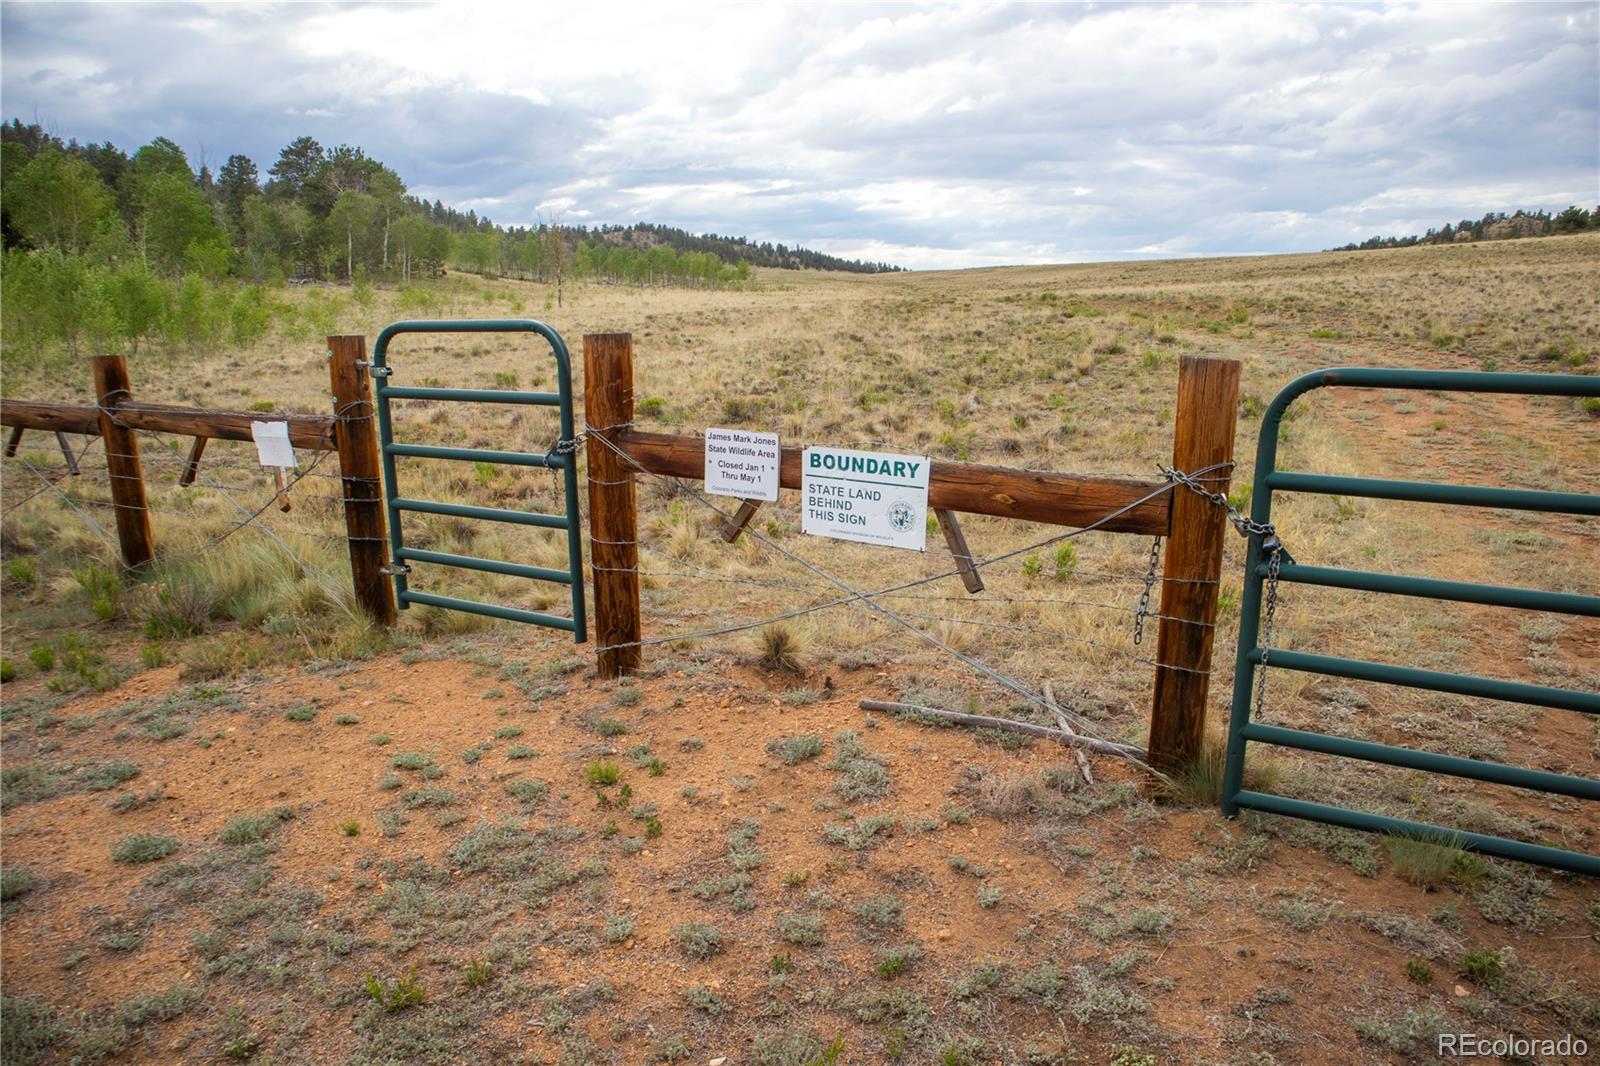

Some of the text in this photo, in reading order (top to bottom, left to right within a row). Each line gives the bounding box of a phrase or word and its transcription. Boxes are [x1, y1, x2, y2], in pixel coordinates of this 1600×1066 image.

[708, 432, 776, 446] James Mark Jones
[708, 444, 775, 458] State Wildlife Area
[718, 460, 744, 470] Closed
[745, 464, 759, 472] Jan
[810, 453, 920, 479] BOUNDARY
[721, 471, 738, 480] Thru
[740, 473, 755, 484] May
[809, 483, 882, 502] STATE LAND
[809, 496, 853, 511] BEHIND
[809, 508, 866, 526] THIS SIGN
